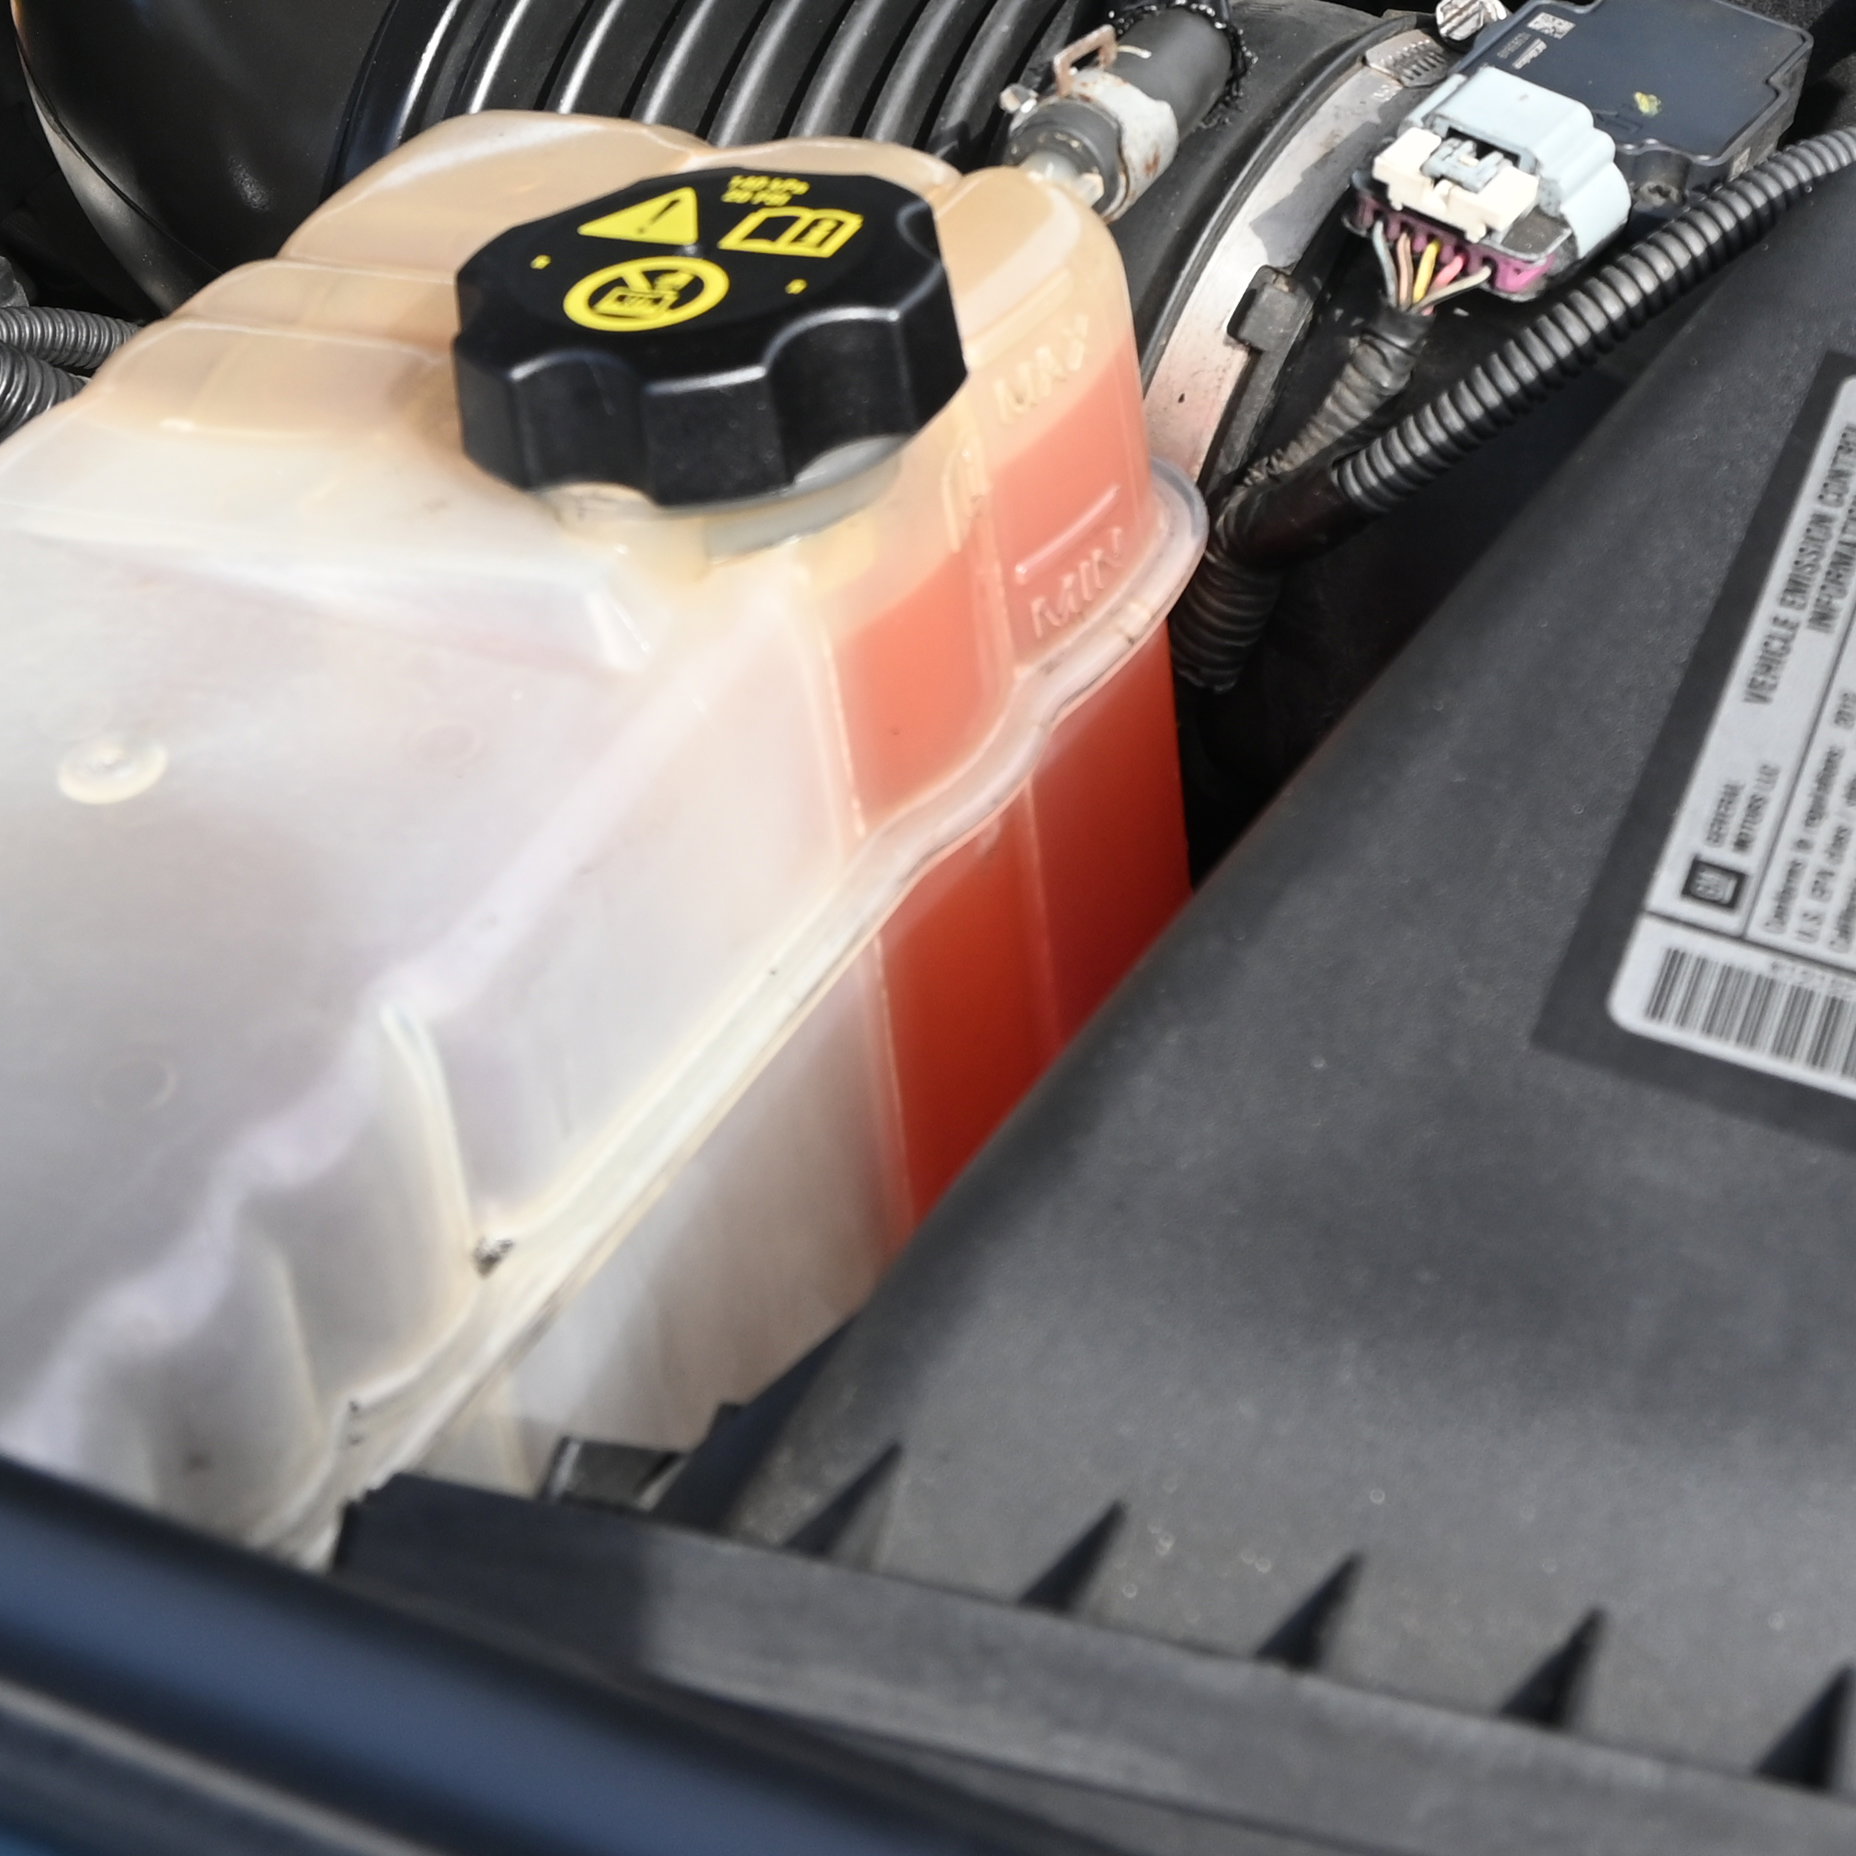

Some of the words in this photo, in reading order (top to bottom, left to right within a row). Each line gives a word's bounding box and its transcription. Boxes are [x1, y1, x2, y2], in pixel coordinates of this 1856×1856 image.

[1742, 615, 1801, 708] VEHICLE
[1777, 511, 1838, 612] EMISSION
[1703, 779, 1746, 847] GENERAL
[1730, 793, 1769, 855] MOTORS
